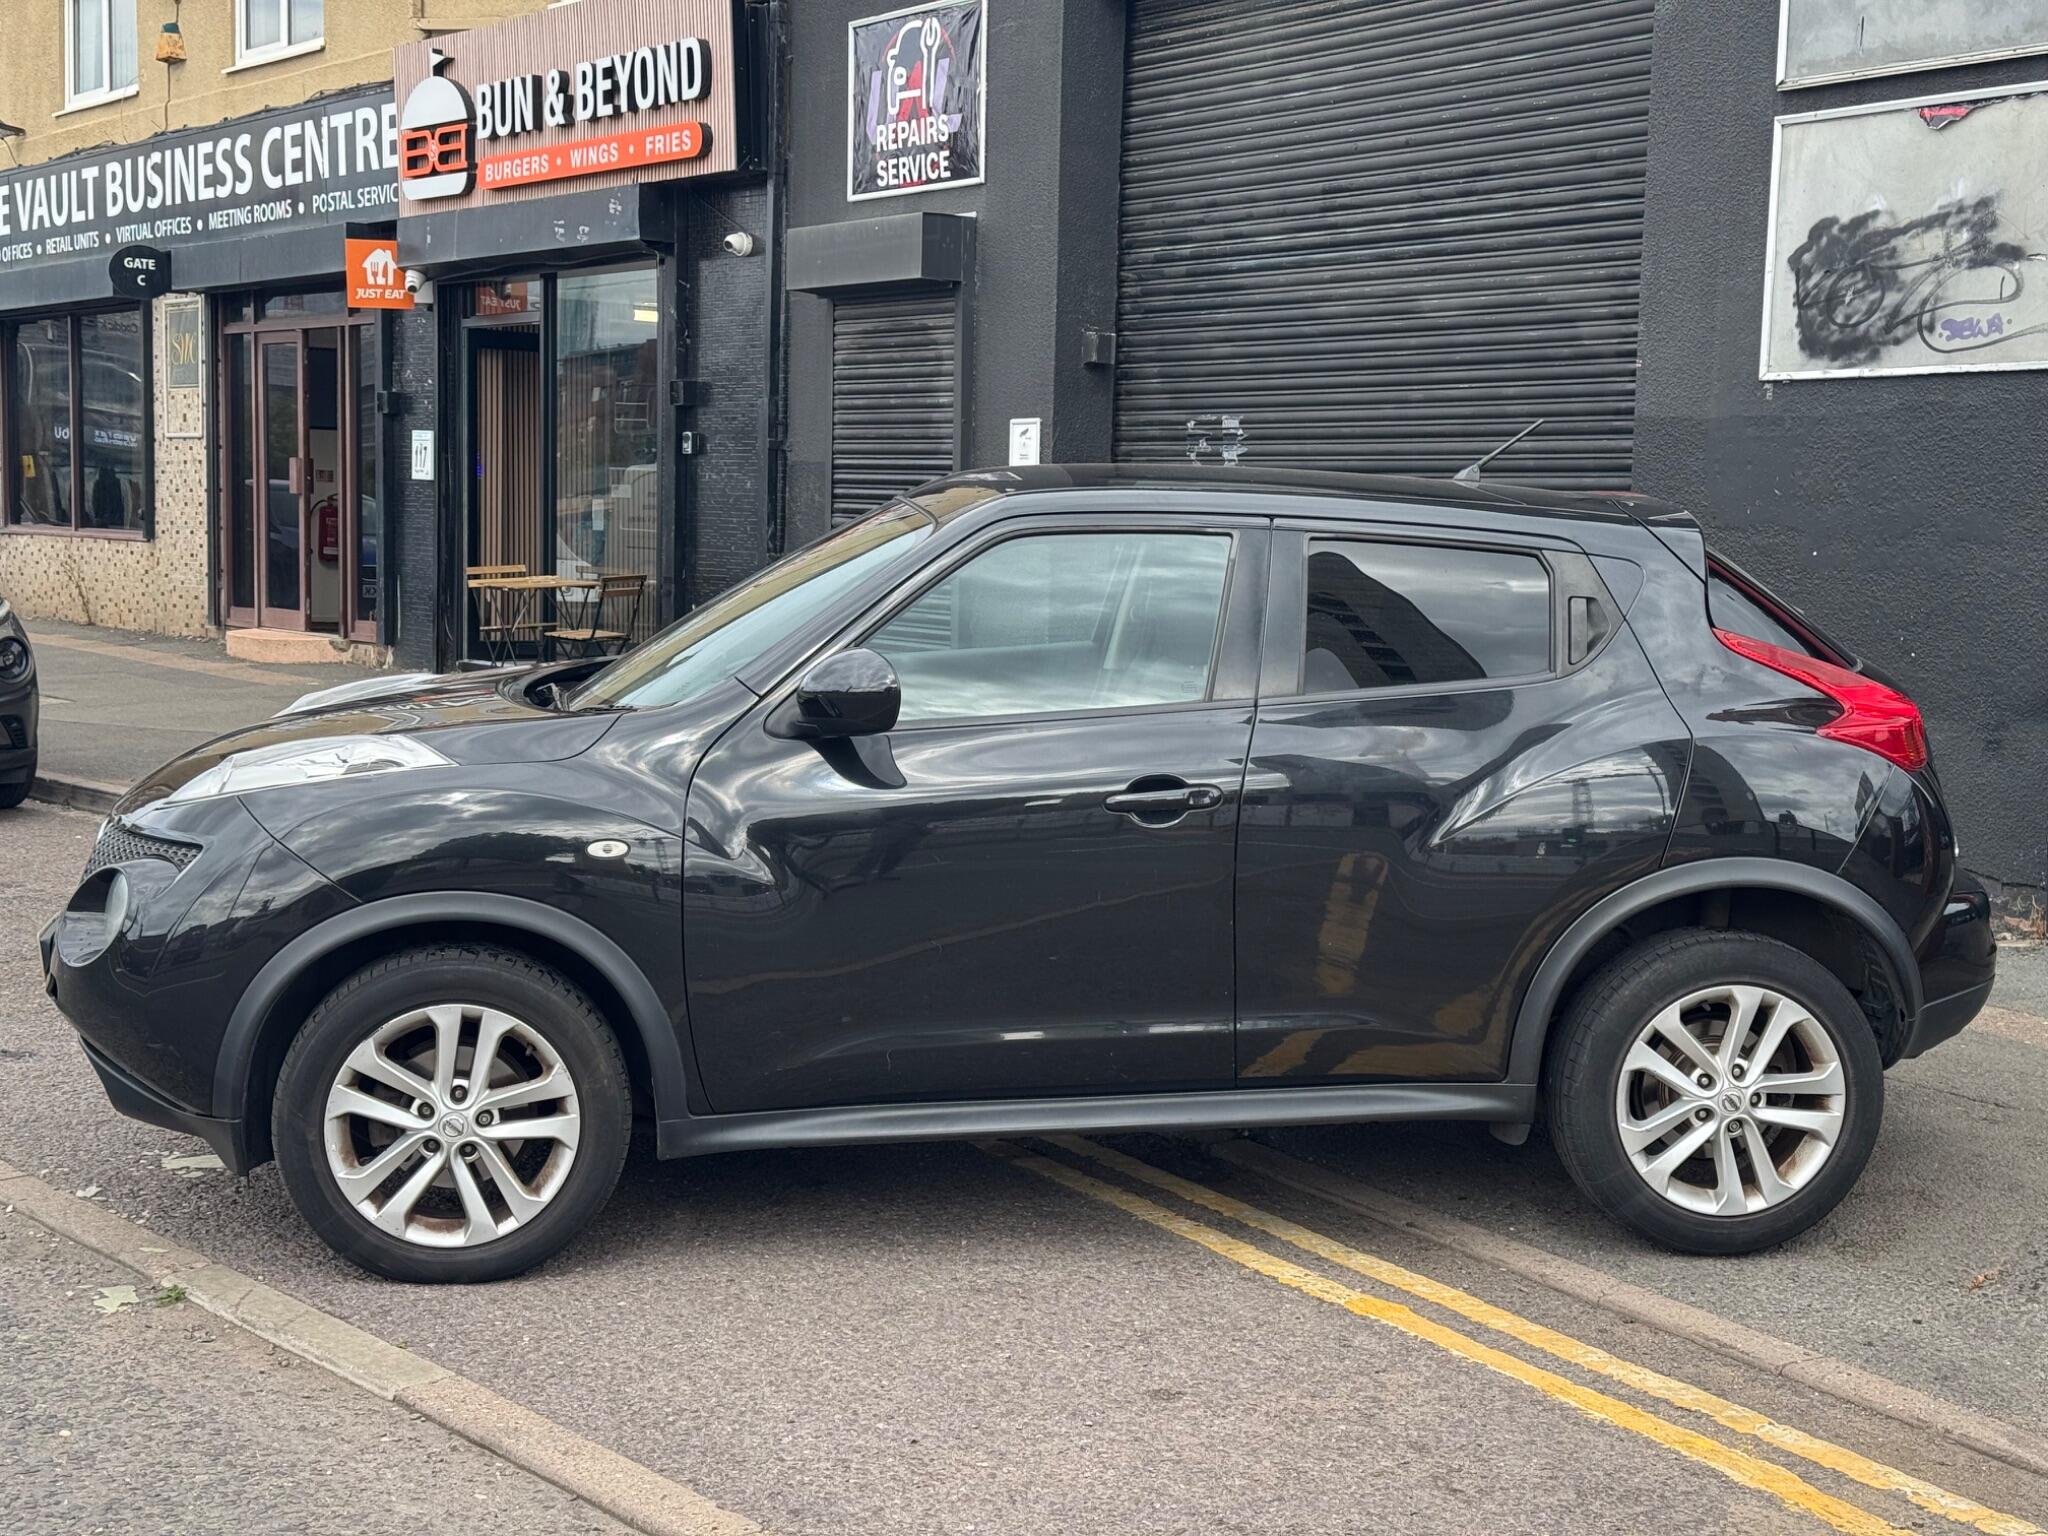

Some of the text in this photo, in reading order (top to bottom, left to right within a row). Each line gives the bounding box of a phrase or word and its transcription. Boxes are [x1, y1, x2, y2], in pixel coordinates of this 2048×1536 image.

[477, 37, 703, 139] BUN & BEYOND
[876, 114, 949, 152] REPAIRS
[14, 166, 99, 231] VAULT
[105, 133, 254, 217] BUSINESS
[260, 102, 399, 189] CENTRE
[485, 130, 692, 182] BURGERS WINGS FRIES
[876, 150, 951, 187] SERVICE
[46, 235, 73, 255] RETAIL
[74, 231, 99, 250] UNITS
[116, 222, 153, 244] VIRTUAL
[154, 216, 192, 238] OFFICES
[208, 206, 252, 231] MEETING
[254, 199, 292, 223] ROOMS
[312, 190, 355, 214] POSTAL
[357, 183, 399, 208] SERVIC
[124, 257, 156, 270] GATE
[137, 275, 146, 286] C
[356, 287, 406, 299] JUST EAT
